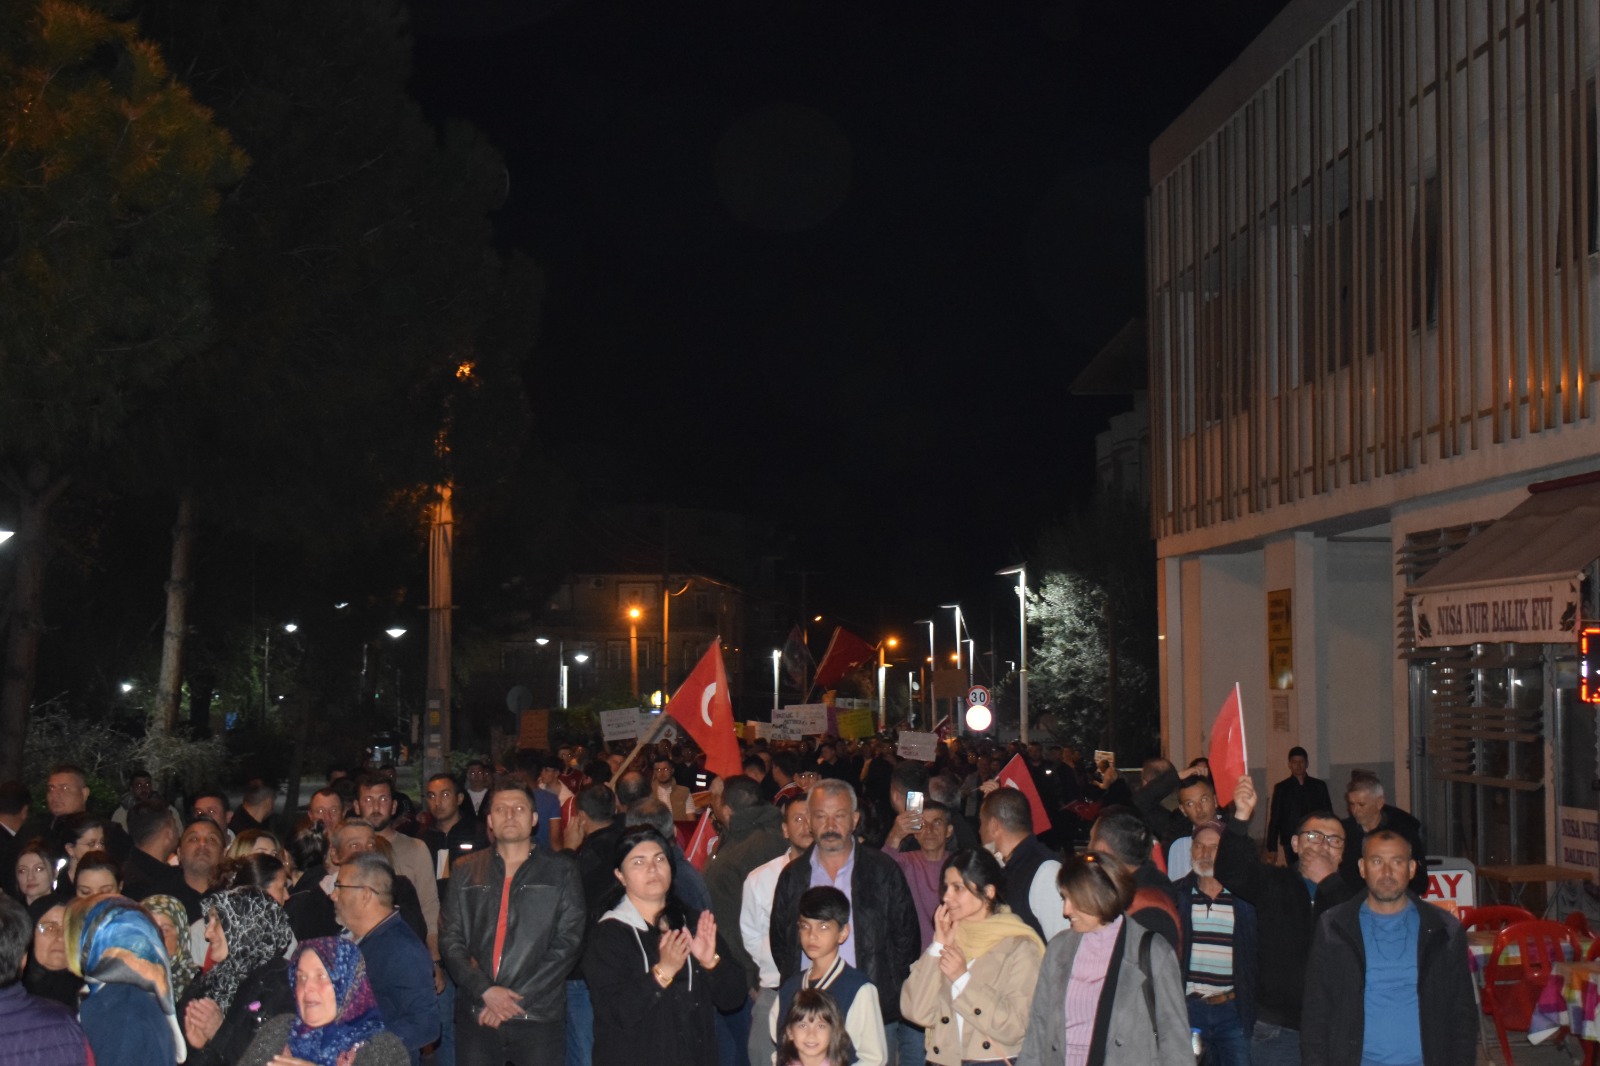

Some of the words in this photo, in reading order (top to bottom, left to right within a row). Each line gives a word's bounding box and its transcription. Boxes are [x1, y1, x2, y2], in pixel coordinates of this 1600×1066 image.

[1465, 602, 1489, 634] NUR
[1492, 598, 1529, 633] BALIK
[970, 691, 986, 703] 30
